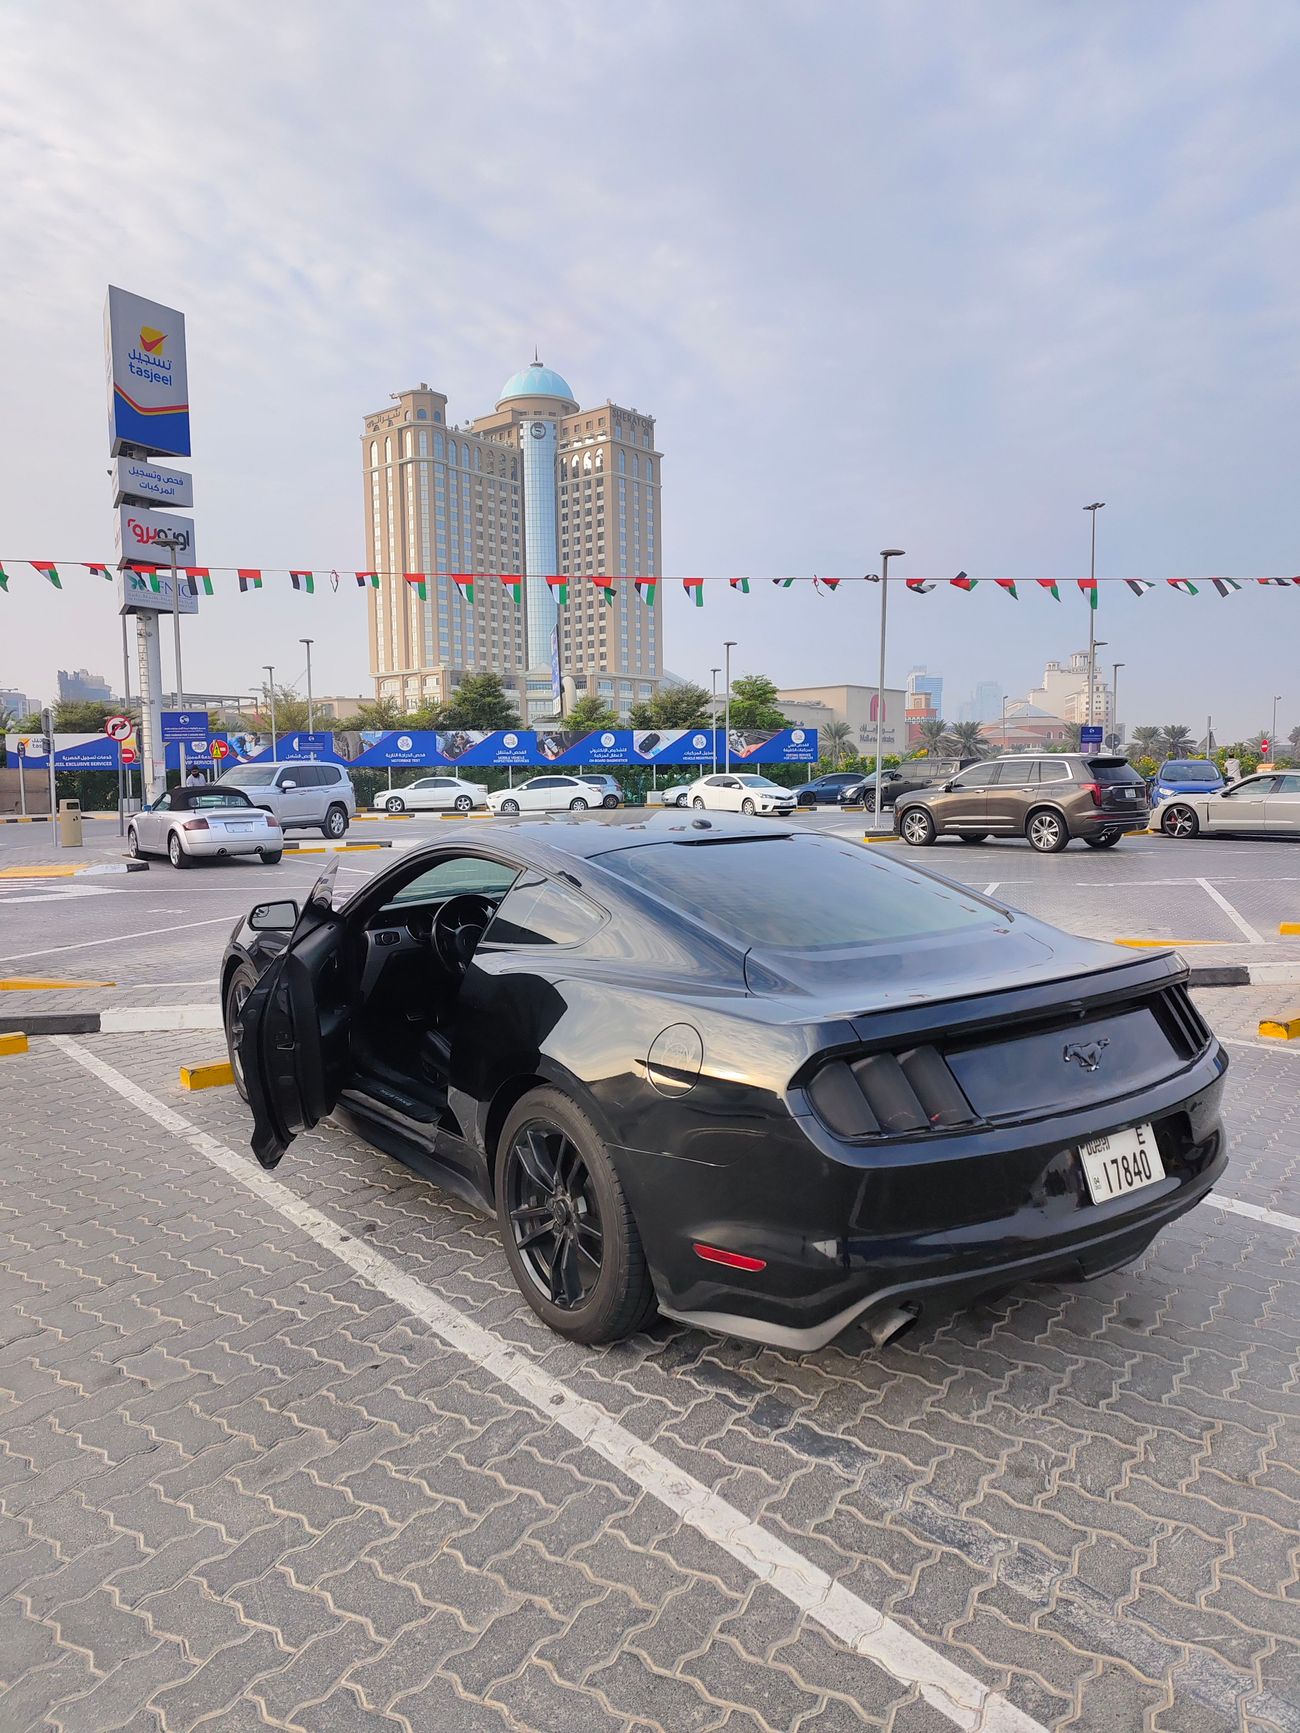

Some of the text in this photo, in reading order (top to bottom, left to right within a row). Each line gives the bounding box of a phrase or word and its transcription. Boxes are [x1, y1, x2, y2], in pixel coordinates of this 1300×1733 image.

[128, 349, 172, 370] تسجيل
[128, 362, 172, 386] tasjeel
[612, 410, 653, 430] SHERATON
[128, 467, 184, 486] فحص وتسجيل
[139, 482, 175, 495] المركبات
[1136, 1126, 1146, 1145] E
[1103, 1149, 1152, 1194] 17840
